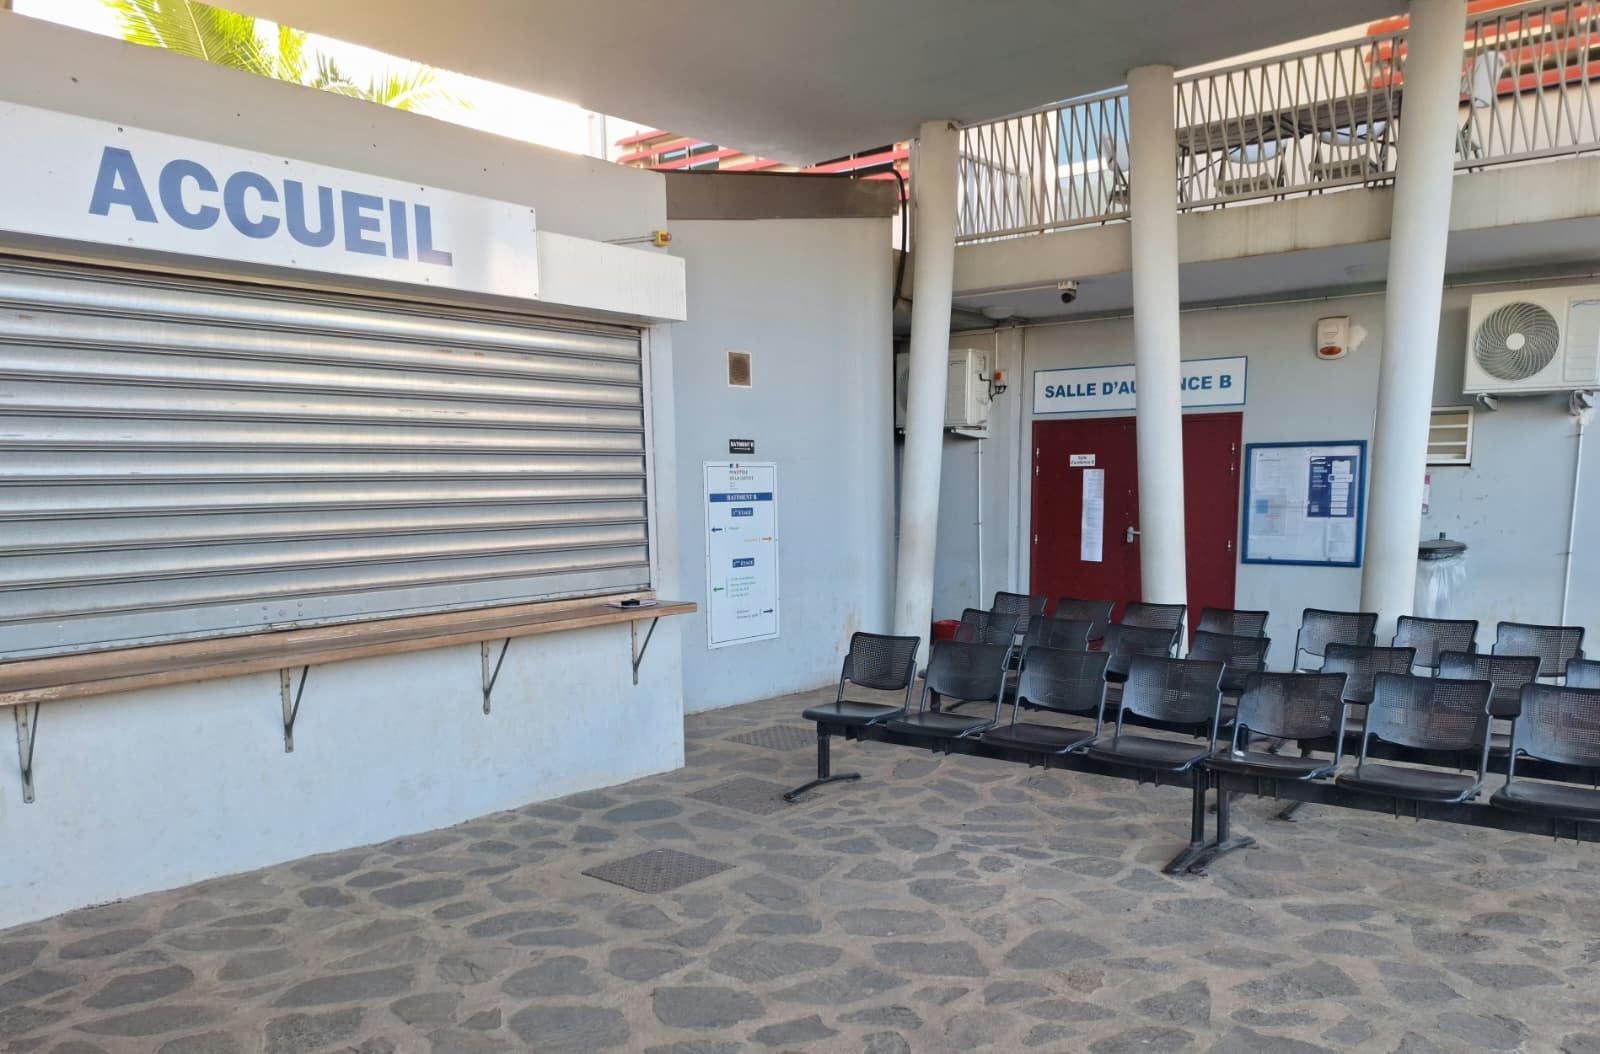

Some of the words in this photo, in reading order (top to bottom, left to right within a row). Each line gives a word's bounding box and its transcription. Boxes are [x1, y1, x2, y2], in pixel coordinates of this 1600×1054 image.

[89, 146, 452, 267] ACCUEIL
[1044, 382, 1097, 398] SALLE
[1102, 375, 1213, 395] D'AUNCE
[1219, 374, 1232, 389] B
